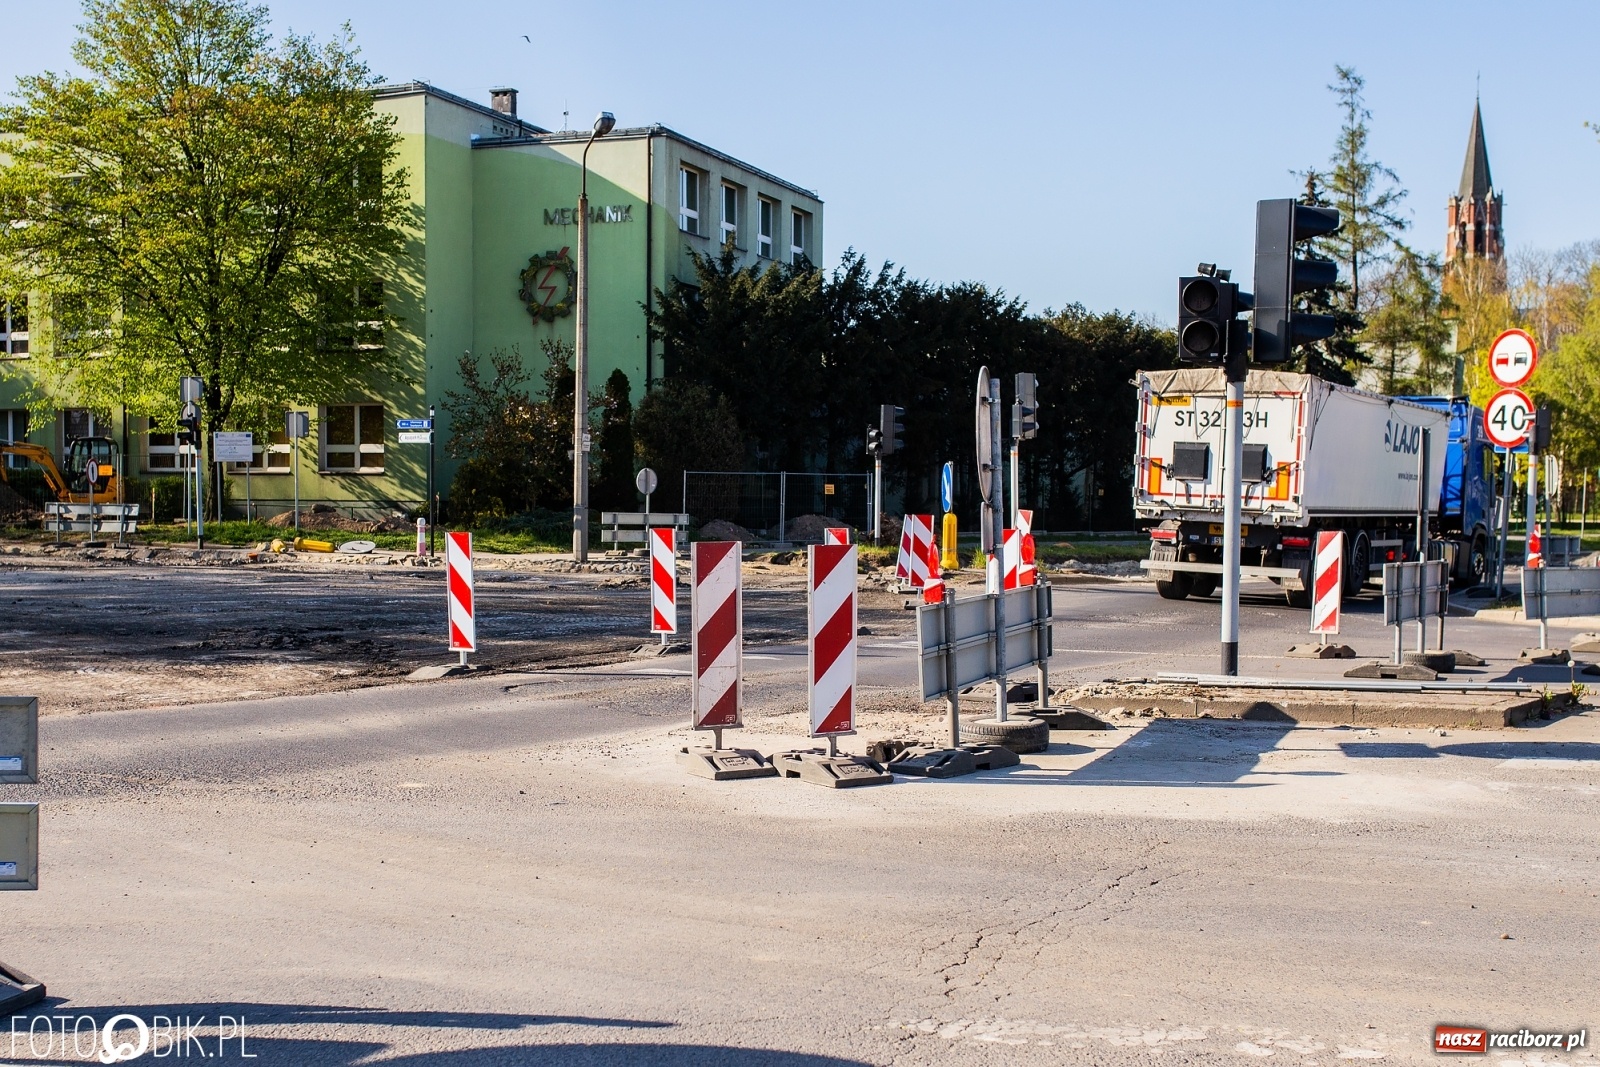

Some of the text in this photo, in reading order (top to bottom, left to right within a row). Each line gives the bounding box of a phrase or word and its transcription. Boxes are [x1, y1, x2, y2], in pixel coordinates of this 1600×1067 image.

[543, 204, 633, 226] MECHANIK
[1174, 410, 1268, 428] ST 323H
[1492, 404, 1527, 431] 40
[1393, 423, 1420, 455] LAJO
